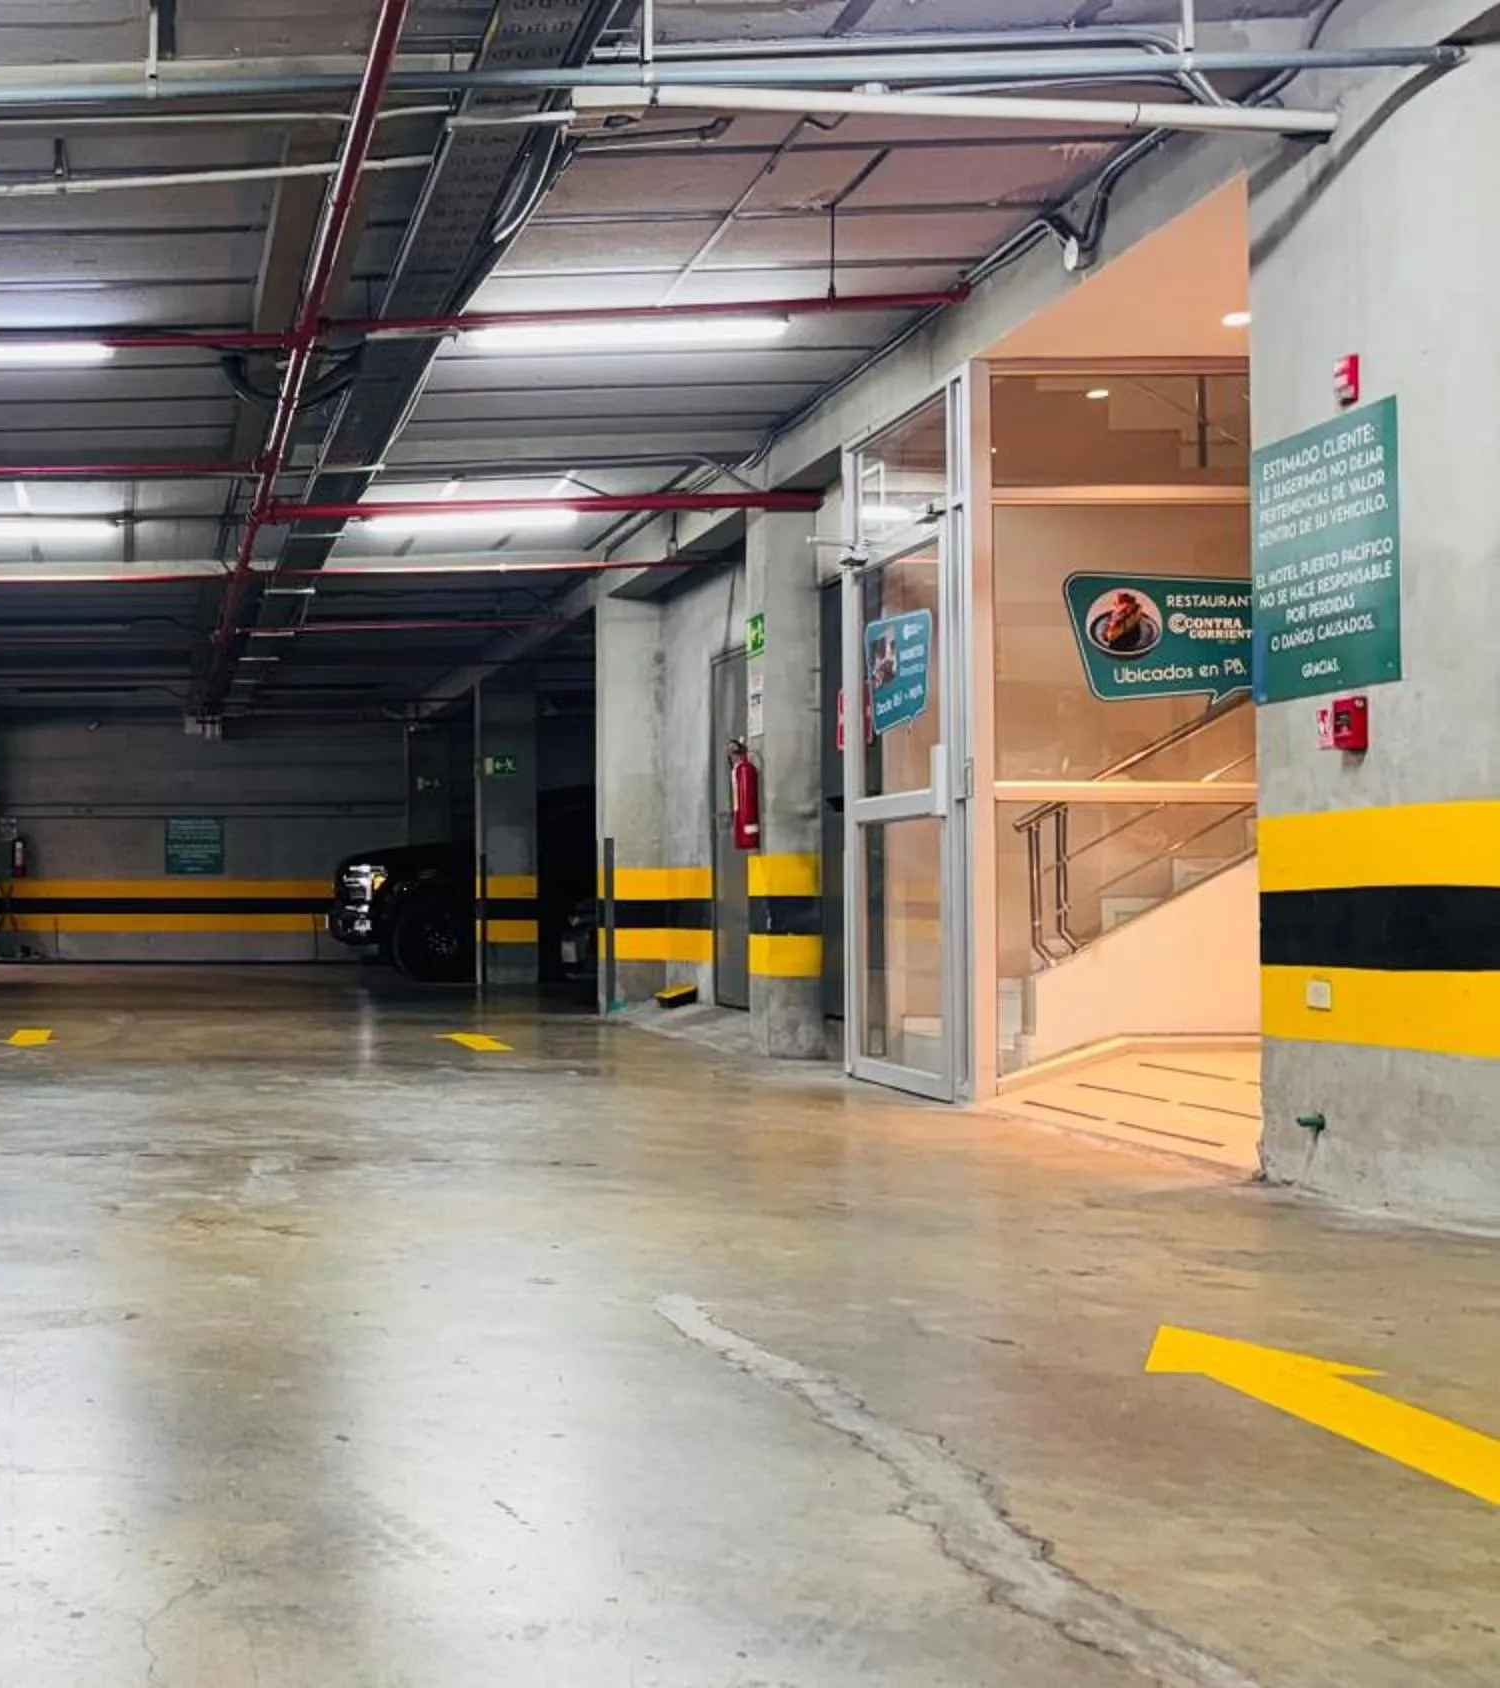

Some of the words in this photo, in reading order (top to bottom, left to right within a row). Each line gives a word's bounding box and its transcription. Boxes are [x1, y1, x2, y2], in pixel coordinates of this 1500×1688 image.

[1263, 445, 1320, 481] ESTIMADO
[1323, 423, 1375, 458] CLIENTE:
[1259, 487, 1271, 505] LE
[1273, 466, 1328, 500] SUGERIMOS
[1330, 459, 1347, 477] NO
[1349, 444, 1385, 471] DEJAR
[1259, 489, 1330, 526] PERTENENCIAS
[1332, 482, 1345, 502] DE
[1347, 469, 1386, 495] VALOR
[1258, 522, 1297, 551] DENTRO
[1298, 515, 1312, 535] DE
[1314, 512, 1328, 530] SU
[1255, 574, 1266, 592] EL
[1266, 563, 1298, 587] HOTEL
[1300, 551, 1339, 577] PUERTO
[1341, 536, 1393, 565] PACÍFICO
[1259, 591, 1275, 610] NO
[1277, 587, 1288, 605] SE
[1289, 578, 1315, 602] HACE
[1317, 559, 1393, 596] RESPONSABLE
[1185, 617, 1242, 630] CONTRA
[1189, 628, 1253, 640] CORRIENT
[1270, 635, 1281, 652] O
[1281, 626, 1316, 650] DAÑOS
[1317, 613, 1376, 639] CAUSADOS.
[1285, 606, 1307, 625] POR
[1113, 664, 1194, 684] Ubicados
[1198, 664, 1220, 678] en
[1301, 657, 1341, 678] GRACIAS.
